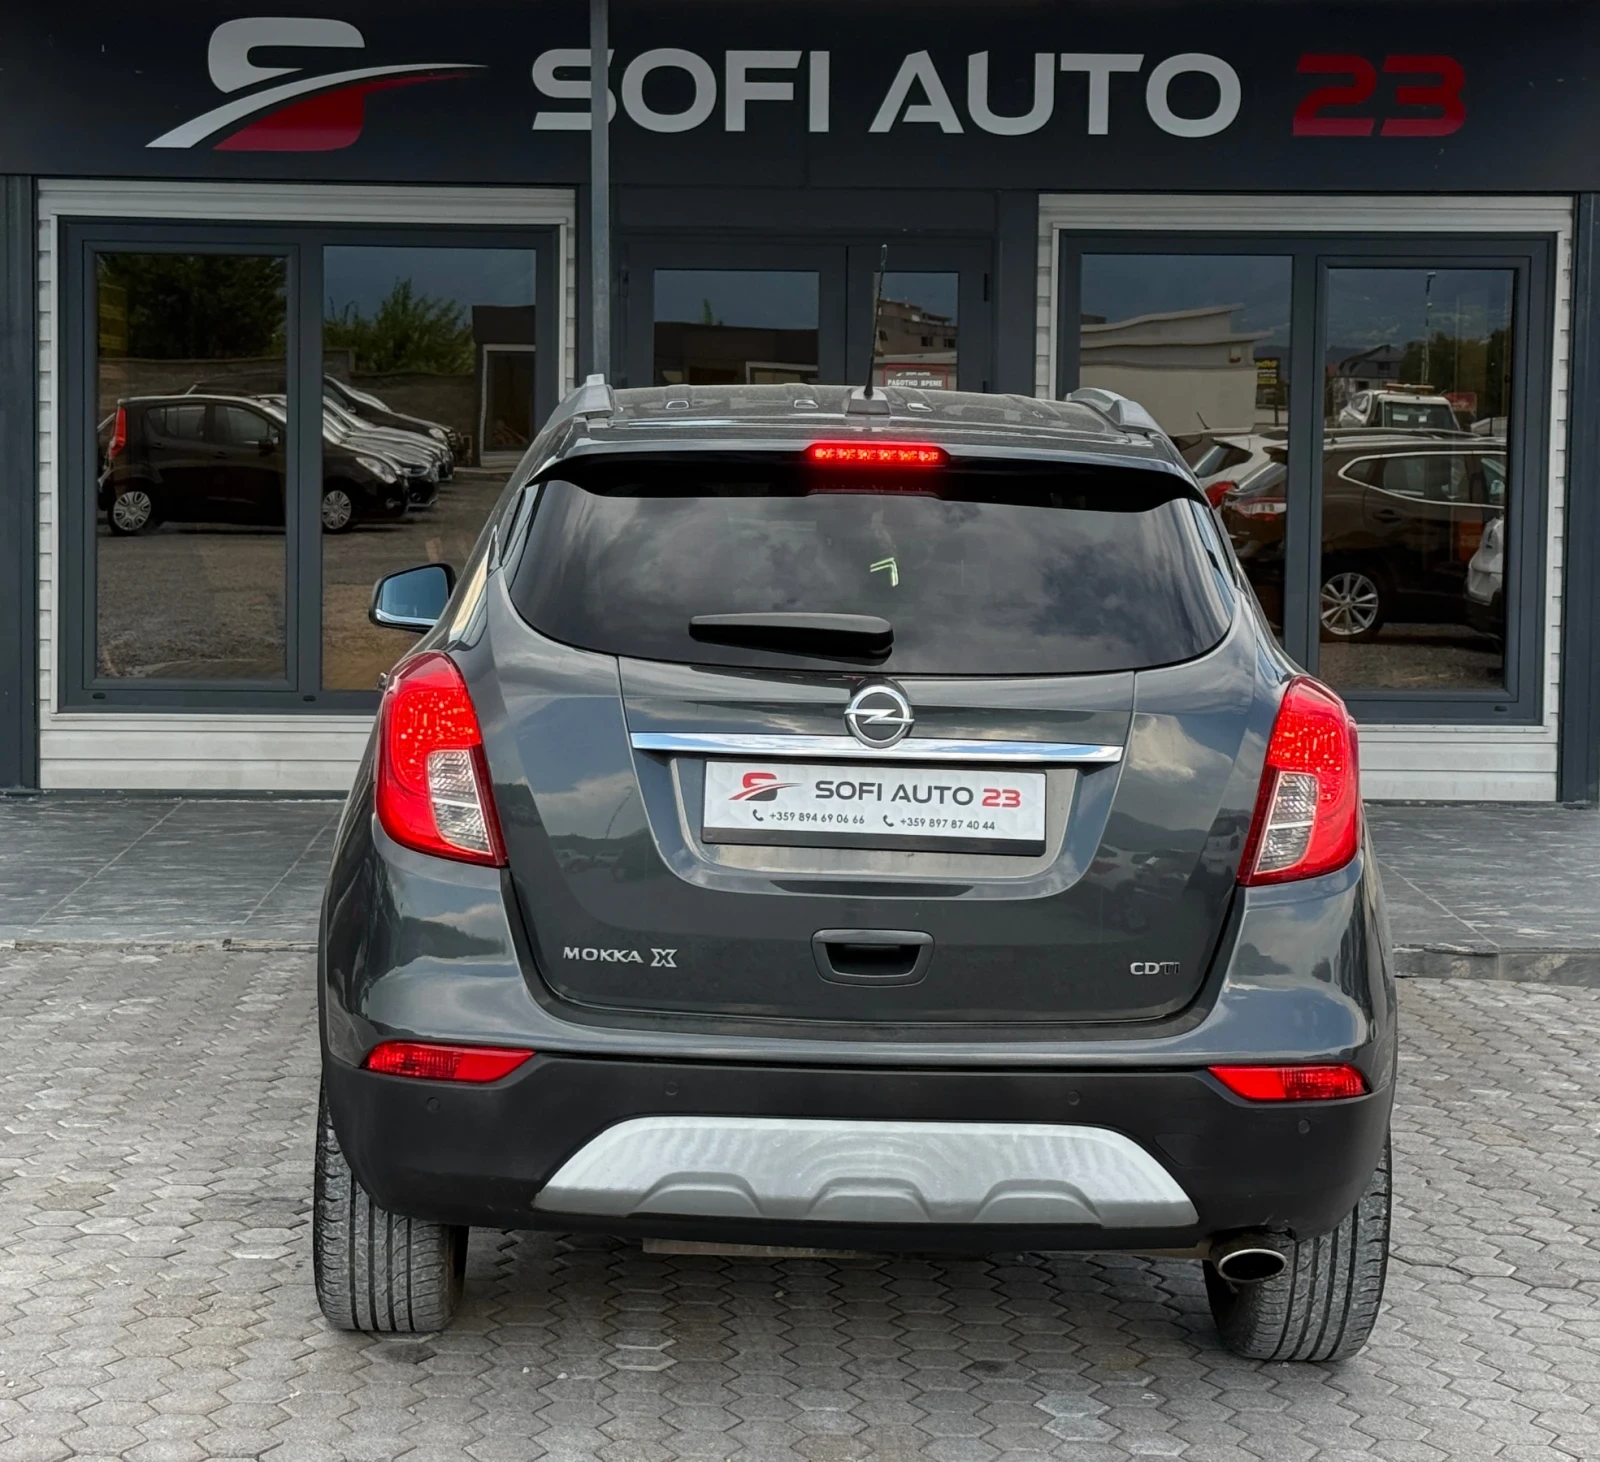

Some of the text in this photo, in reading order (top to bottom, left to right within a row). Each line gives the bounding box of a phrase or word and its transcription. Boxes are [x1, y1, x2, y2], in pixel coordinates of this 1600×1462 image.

[532, 48, 1467, 137] SOFI AUTO 23
[815, 780, 1021, 808] SOFI AUTO 23
[769, 811, 865, 824] +359 894 69 06 66
[900, 817, 996, 831] +359 897 87 40 44
[563, 946, 678, 968] MOKKA X
